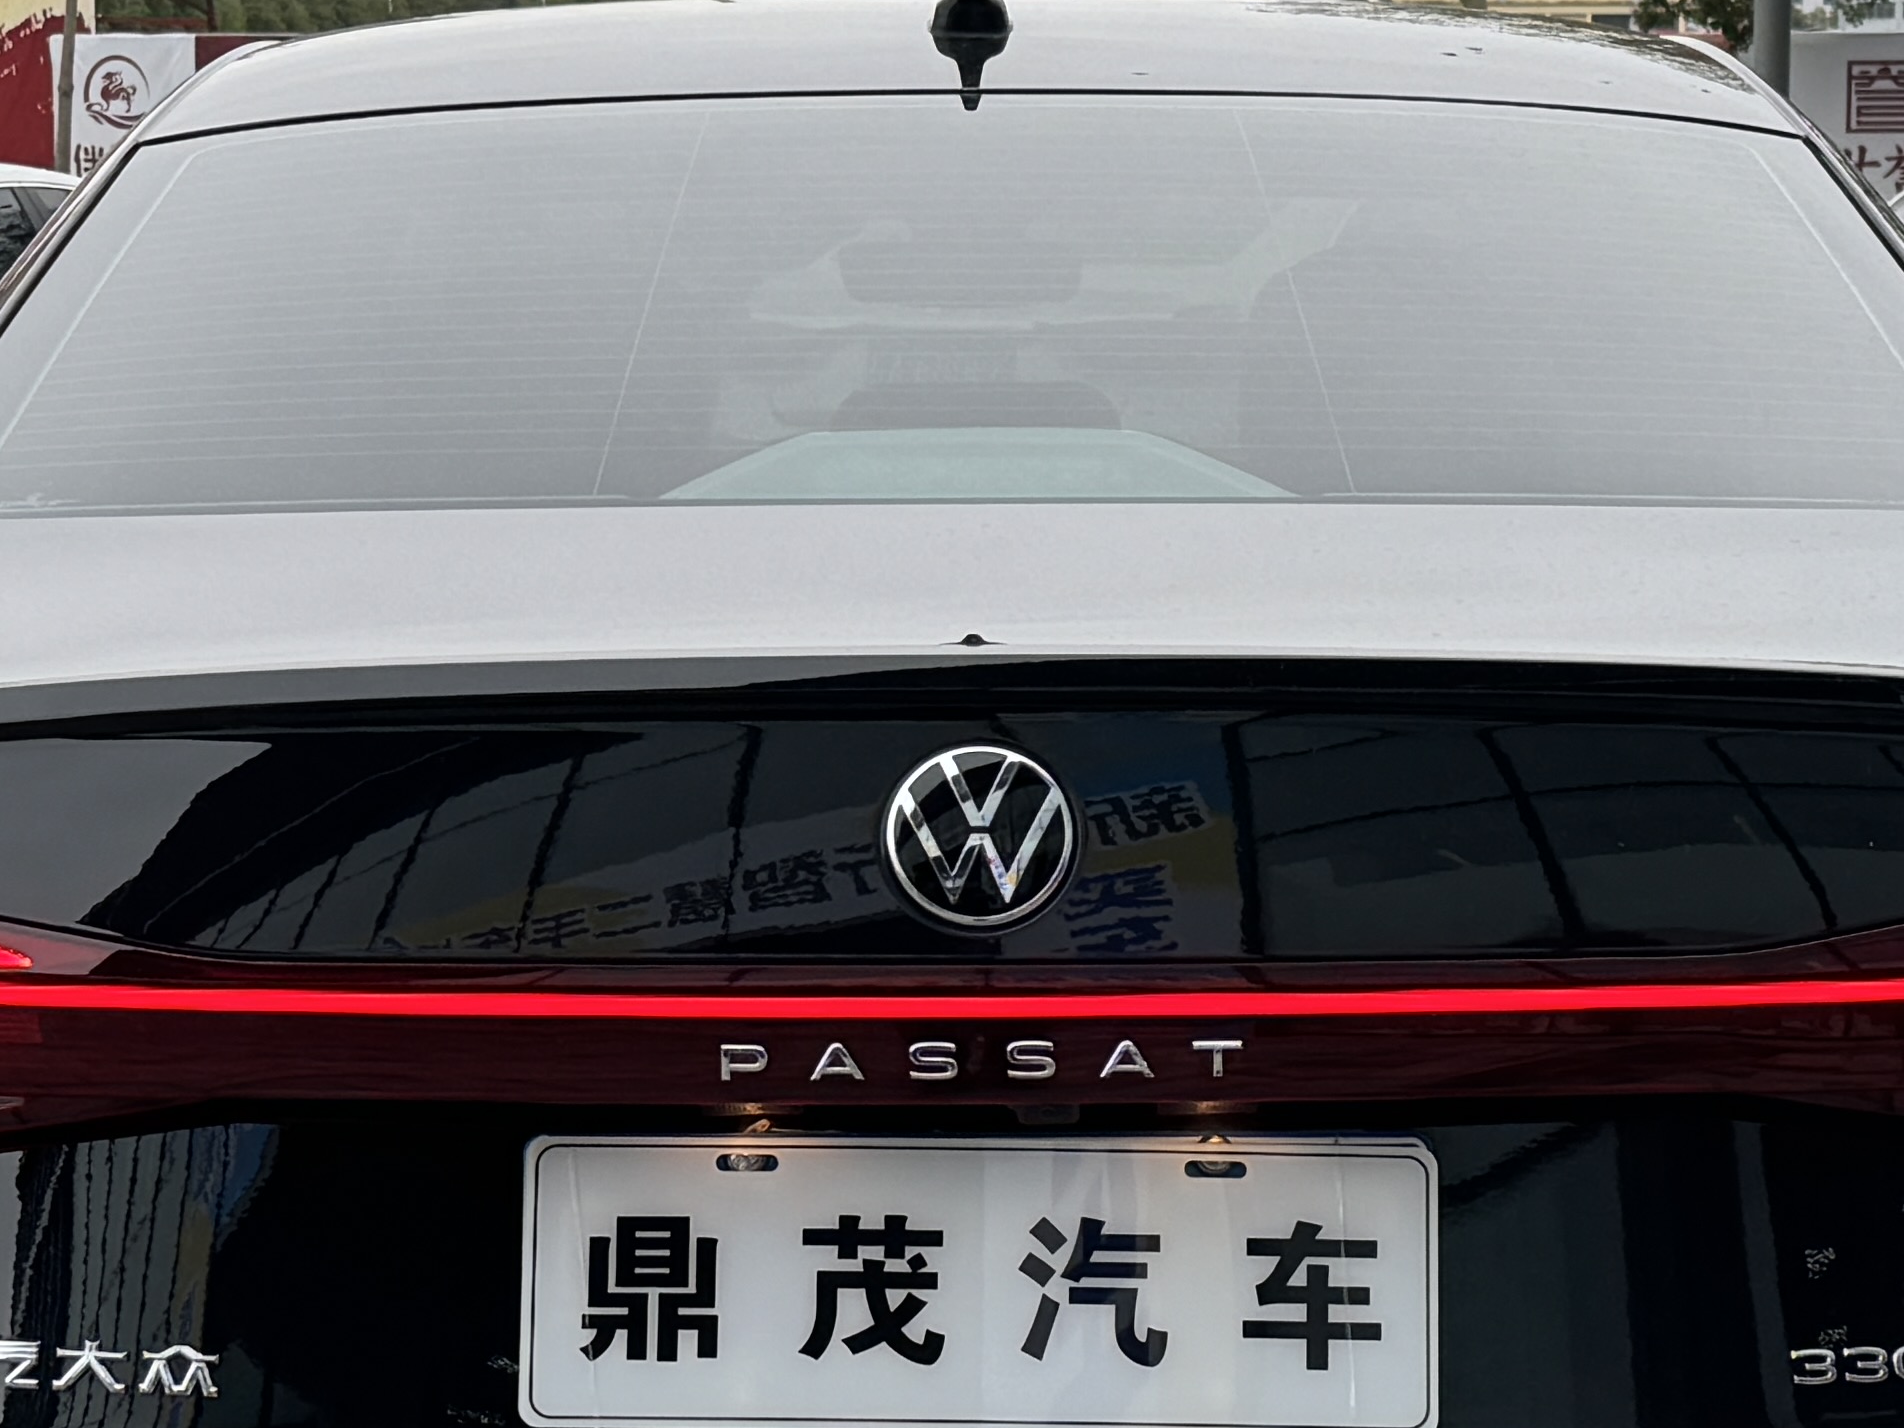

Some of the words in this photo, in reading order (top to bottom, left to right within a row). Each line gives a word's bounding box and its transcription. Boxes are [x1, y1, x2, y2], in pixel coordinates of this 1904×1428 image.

[718, 1038, 1245, 1083] PASSAT
[579, 1214, 1385, 1372] 鼎茂汽车
